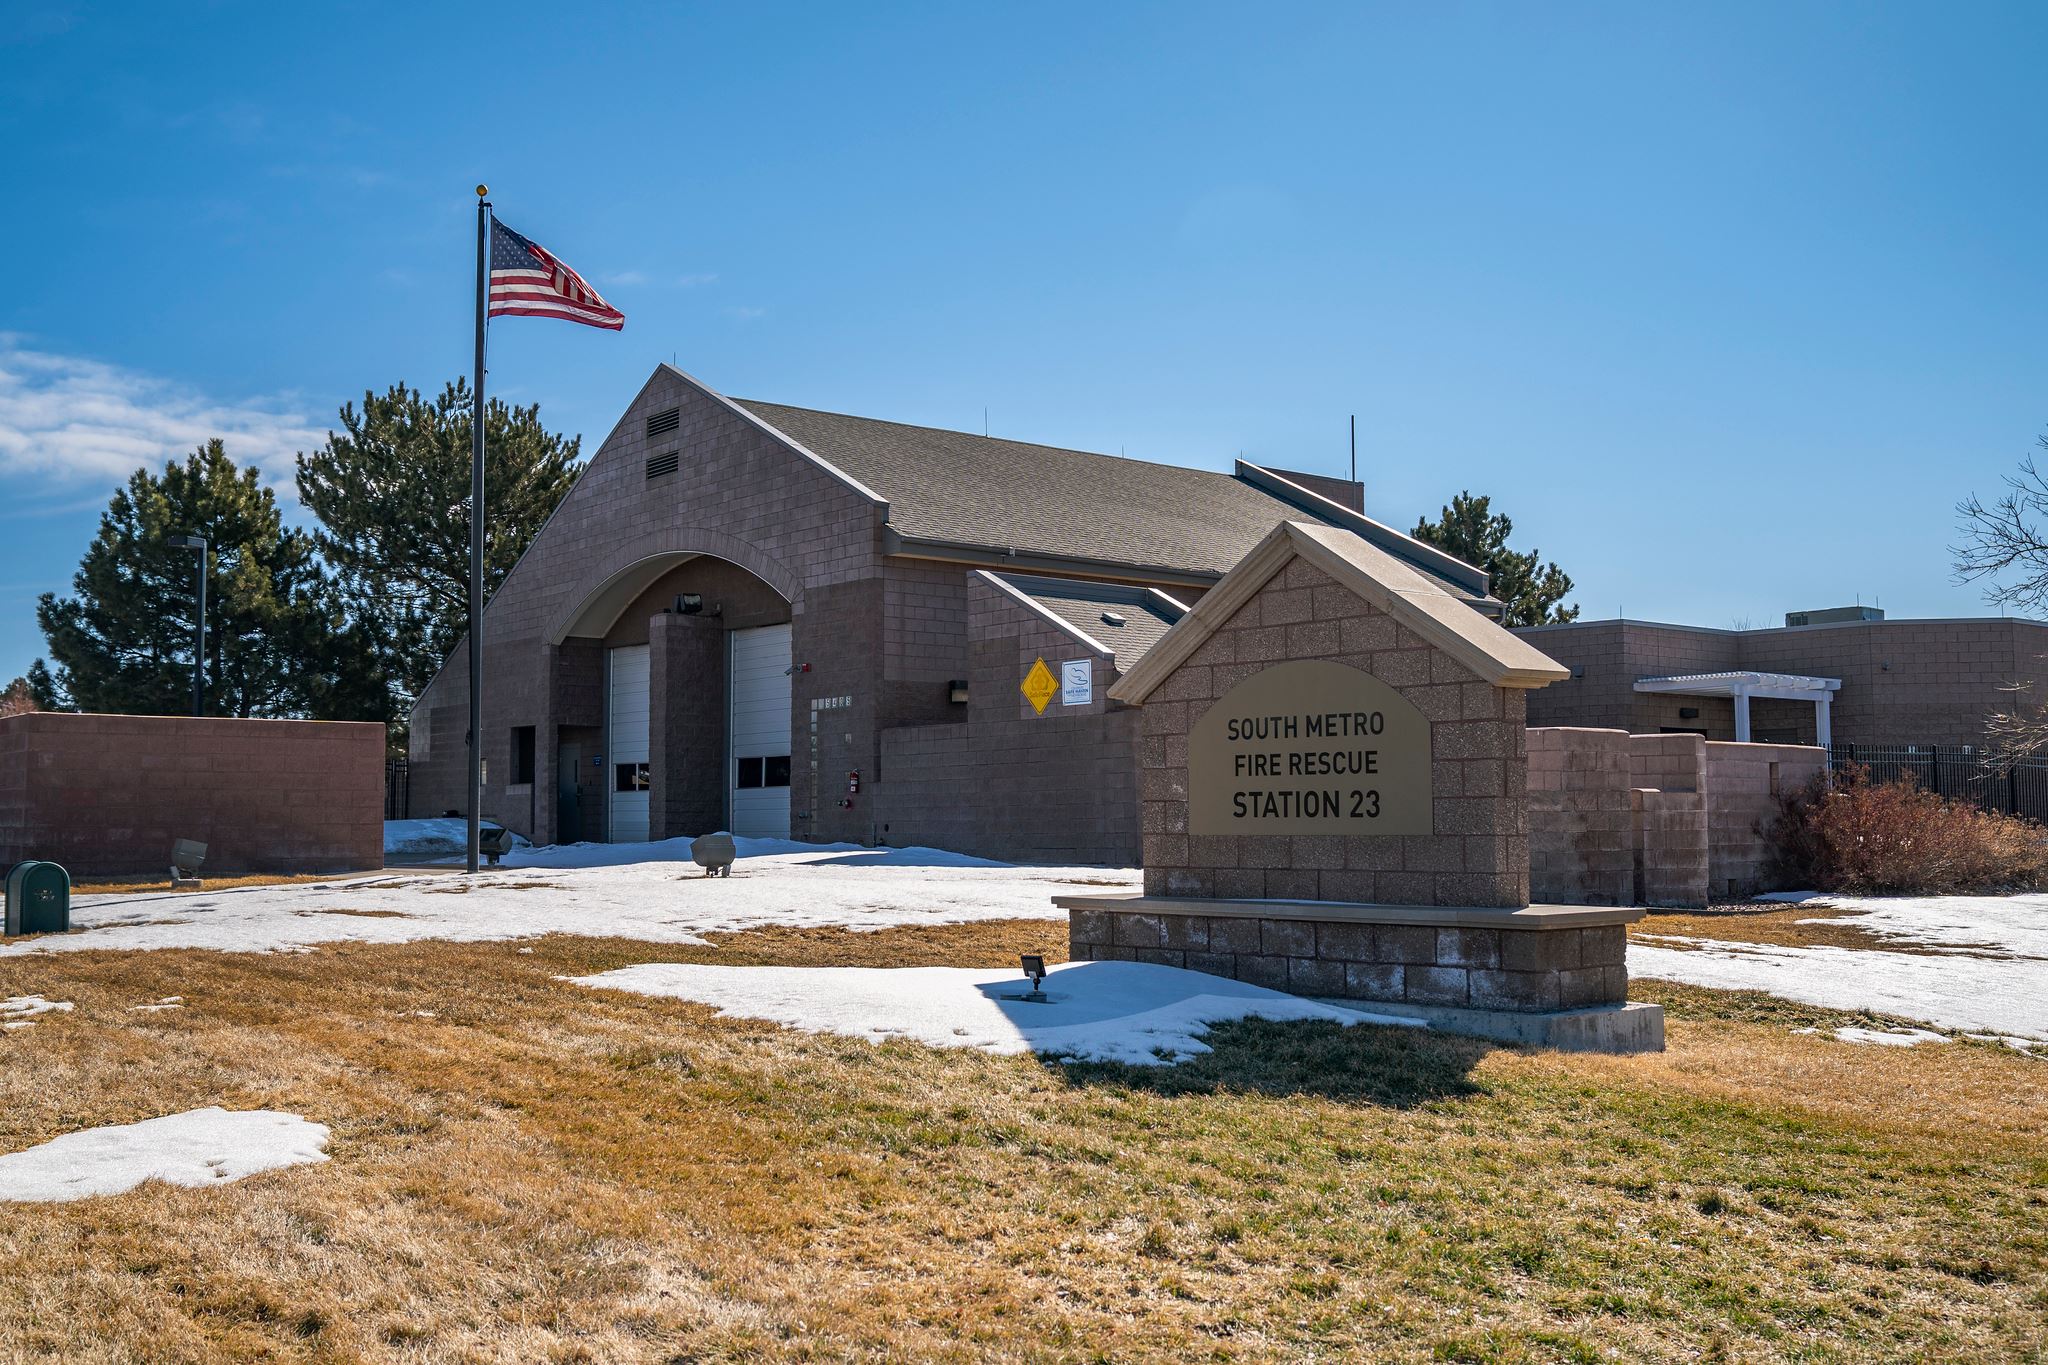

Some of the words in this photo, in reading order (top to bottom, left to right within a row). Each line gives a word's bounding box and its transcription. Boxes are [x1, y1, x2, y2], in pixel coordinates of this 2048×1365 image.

[1227, 715, 1298, 741] SOUTH
[1305, 711, 1384, 738] METRO
[1234, 754, 1282, 777] FIRE
[1288, 750, 1378, 776] RESCUE
[1232, 790, 1340, 819] STATION
[1349, 789, 1381, 819] 23
